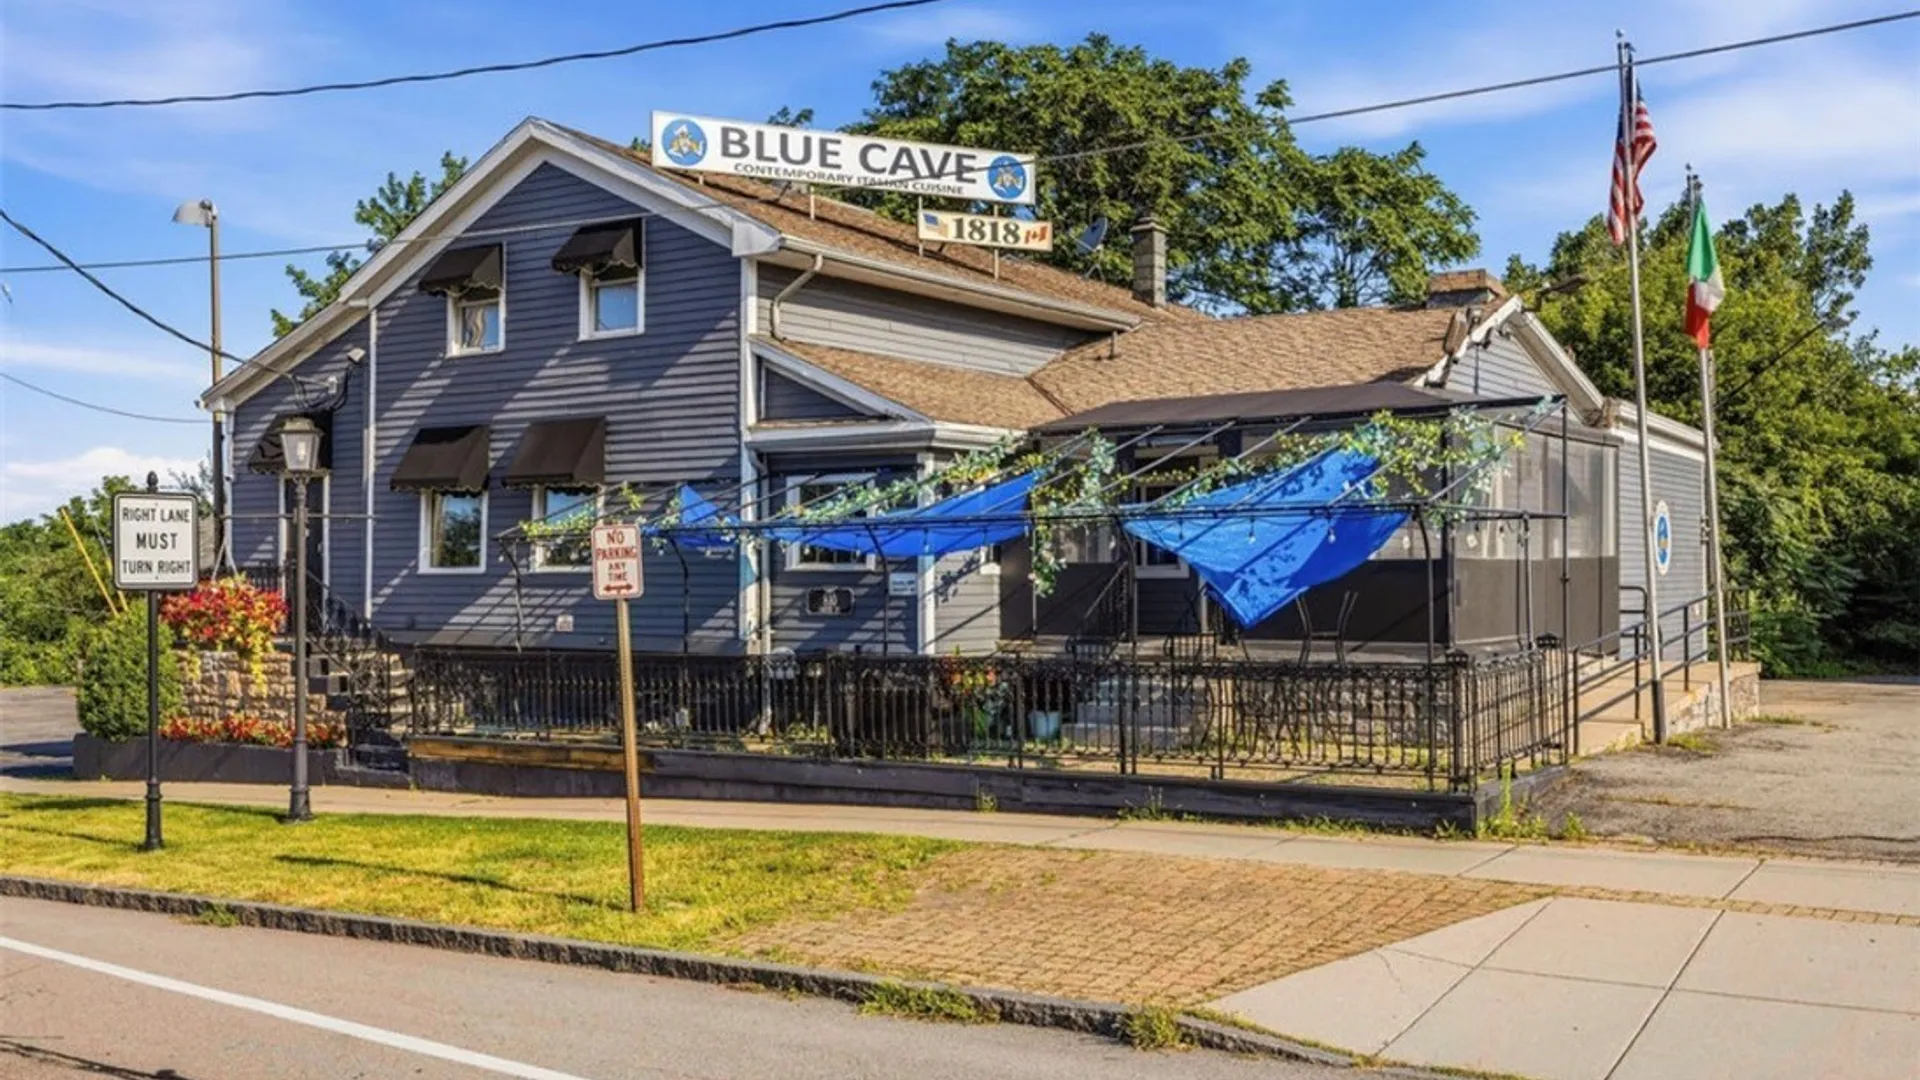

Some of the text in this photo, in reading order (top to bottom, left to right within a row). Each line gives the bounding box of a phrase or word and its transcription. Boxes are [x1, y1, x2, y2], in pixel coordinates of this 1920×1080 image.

[721, 126, 977, 184] BLUE CAVE
[734, 162, 853, 185] CONTEMPORARY
[912, 181, 964, 194] CUISINE
[953, 217, 1020, 245] 1818
[122, 507, 190, 523] RIGHT LANE
[136, 532, 178, 550] MUST
[607, 529, 625, 545] NO
[596, 546, 637, 560] PARKING
[122, 560, 191, 574] TURN RIGHT
[608, 562, 626, 571] ANY
[608, 571, 628, 581] TIME
